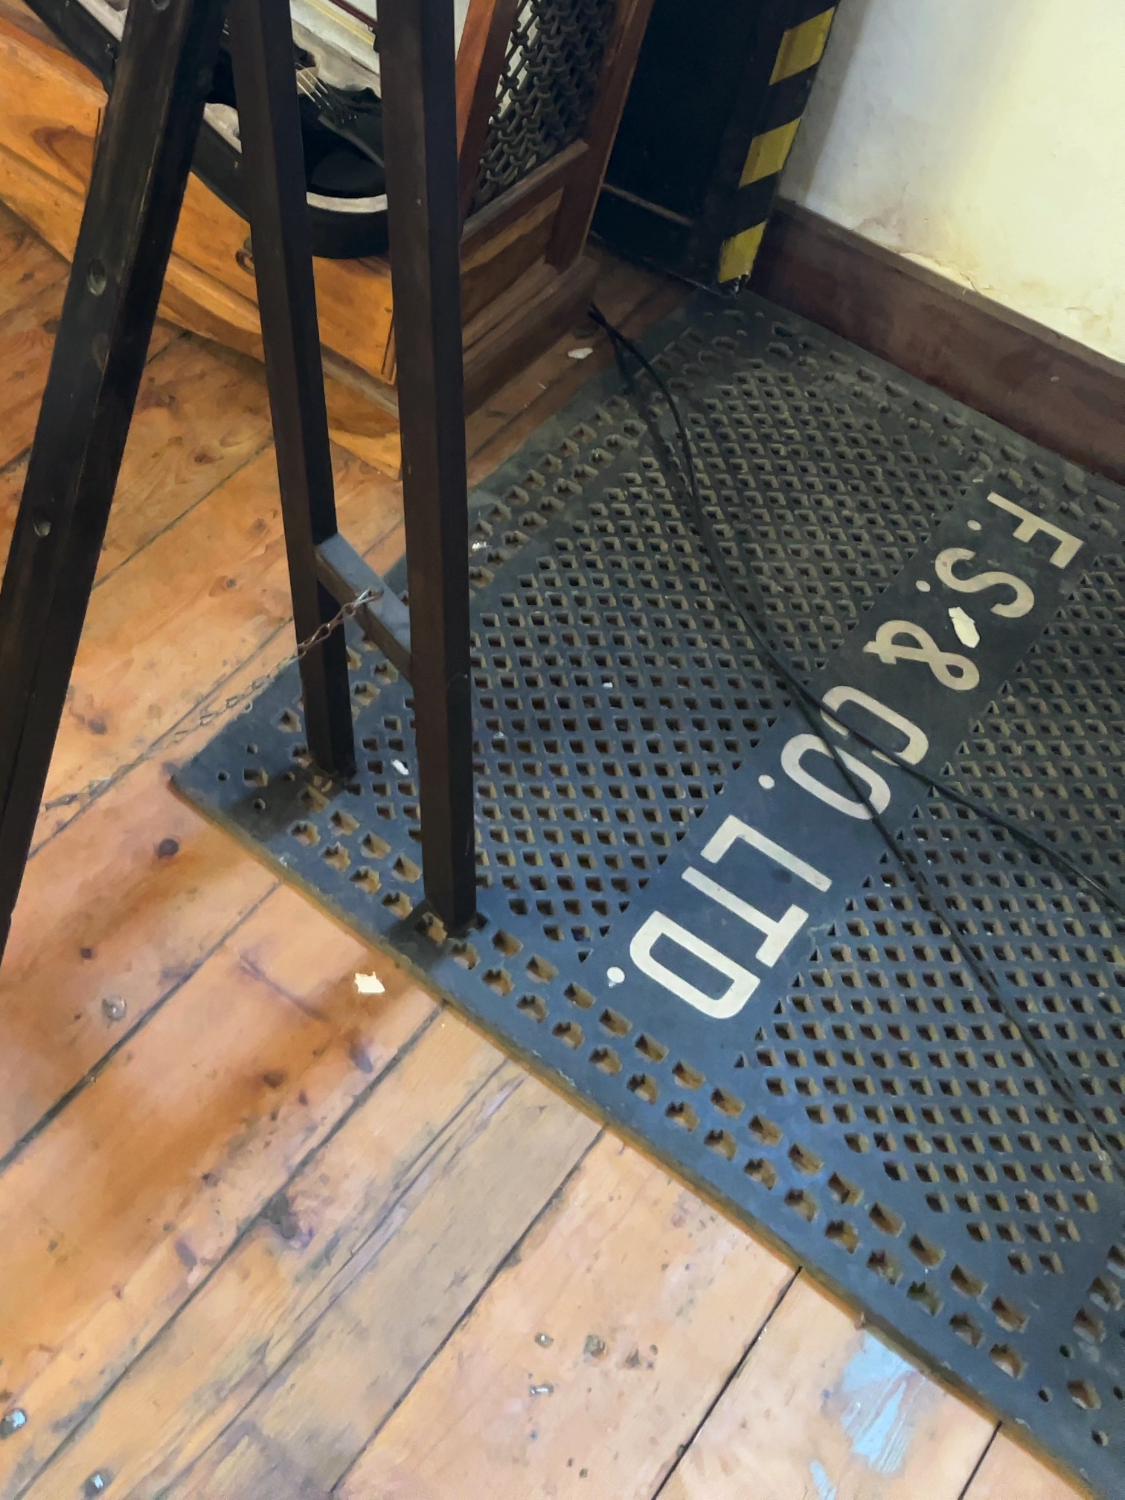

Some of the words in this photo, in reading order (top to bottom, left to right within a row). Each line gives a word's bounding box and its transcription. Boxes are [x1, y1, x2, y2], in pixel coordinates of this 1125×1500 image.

[863, 620, 980, 691] &
[758, 685, 929, 820] CO.
[606, 814, 832, 1020] LTD.
